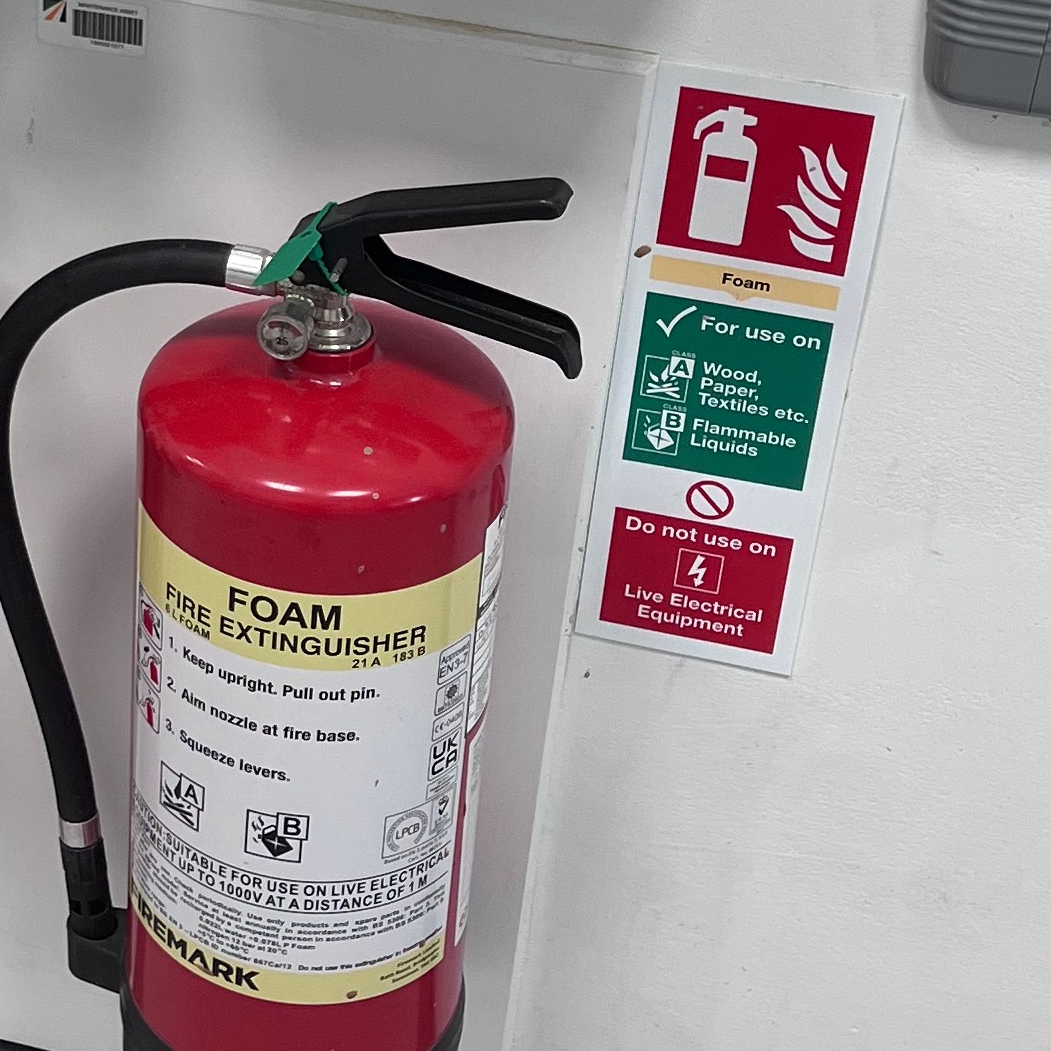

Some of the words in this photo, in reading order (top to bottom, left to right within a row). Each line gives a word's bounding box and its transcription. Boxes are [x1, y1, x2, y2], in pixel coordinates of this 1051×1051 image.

[721, 272, 771, 292] Foam
[701, 315, 739, 336] For
[745, 325, 786, 344] use
[793, 335, 821, 350] on
[671, 350, 696, 359] CLASS
[672, 360, 690, 376] A
[703, 361, 762, 386] Wood,
[700, 377, 759, 401] Paper,
[663, 403, 687, 412] CLASS
[665, 413, 683, 429] B
[698, 392, 769, 417] Textiles
[774, 408, 809, 423] etc.
[690, 434, 758, 457] Liquids
[692, 418, 797, 448] Flammable
[625, 516, 655, 534] Do
[662, 524, 698, 542] not
[704, 534, 742, 550] use
[749, 542, 776, 557] on
[228, 586, 342, 630] FOAM
[624, 584, 664, 603] Live
[670, 593, 763, 622] Electrical
[166, 582, 211, 628] FIRE
[219, 616, 427, 656] EXTINGUISHER
[179, 614, 211, 640] FOAM
[637, 604, 744, 637] Equipment
[168, 636, 178, 652] 1.
[183, 646, 214, 675] Keep
[218, 665, 277, 696] upright.
[282, 683, 313, 701] Pull
[319, 688, 346, 701] out
[350, 687, 380, 703] pin.
[352, 658, 368, 669] 21
[370, 657, 381, 668] A
[391, 651, 415, 664] 183
[166, 676, 176, 694] 2.
[181, 689, 206, 711] Aim
[210, 705, 258, 732] nozzle
[262, 724, 280, 737] at
[283, 726, 311, 741] fire
[316, 728, 360, 742] base.
[165, 718, 175, 736] 3.
[179, 730, 236, 768] Squeeze
[240, 757, 291, 783] levers.
[433, 730, 459, 759] UK
[431, 749, 457, 776] CA
[184, 783, 199, 805] A
[283, 817, 302, 836] B
[395, 823, 420, 840] LPCB
[179, 857, 194, 874] UP
[197, 869, 215, 887] TO
[219, 880, 263, 903] 1000V
[265, 895, 286, 907] AT
[288, 898, 299, 910] A
[303, 892, 382, 911] DISTANCE
[387, 885, 405, 901] OF
[409, 881, 414, 892] 1
[418, 874, 427, 888] M
[231, 870, 262, 890] FOR
[267, 879, 299, 896] USE
[303, 885, 326, 897] ON
[331, 882, 366, 897] LIVE
[370, 847, 449, 892] ELECTRICAL
